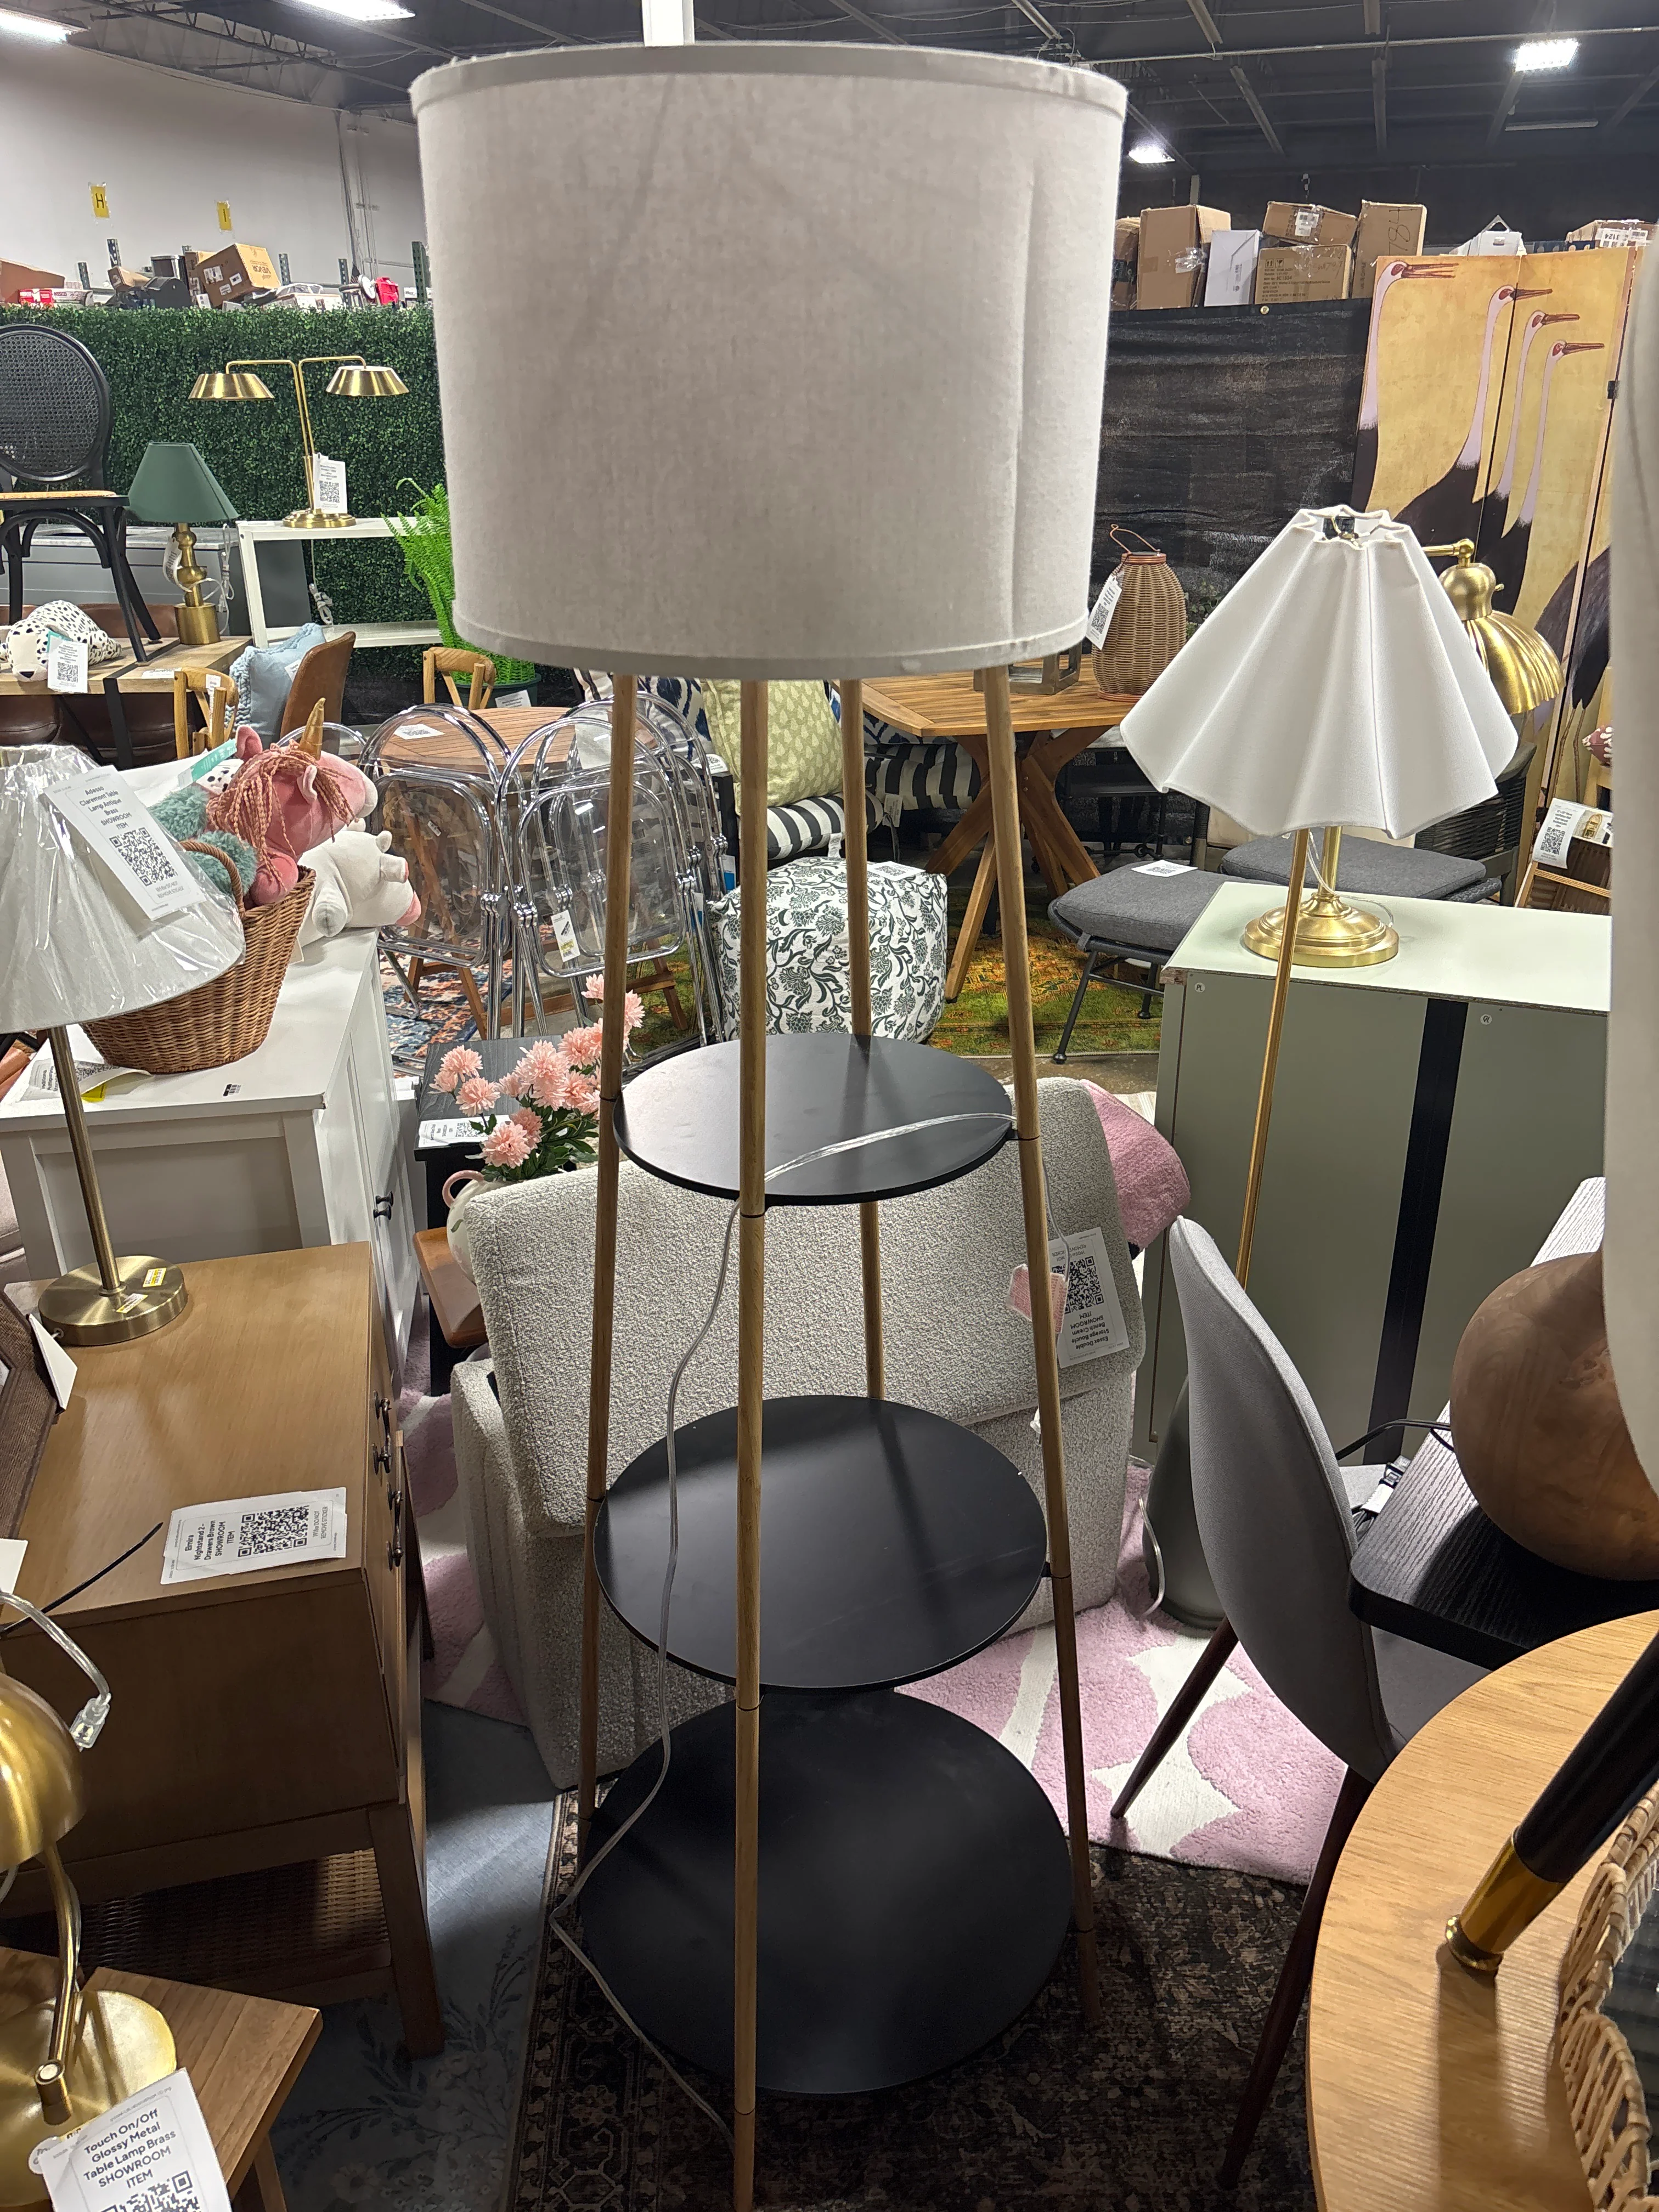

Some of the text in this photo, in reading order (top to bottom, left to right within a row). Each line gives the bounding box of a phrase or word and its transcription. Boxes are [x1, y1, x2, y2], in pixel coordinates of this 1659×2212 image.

[95, 193, 104, 208] H
[84, 786, 104, 795] Adesso
[79, 793, 107, 806] Claremont
[88, 798, 122, 812] Lamp Antique
[100, 812, 132, 826] SHOWROOM
[1070, 1315, 1104, 1329] SHOWROOM
[1079, 1311, 1092, 1319] ITEM
[1090, 1322, 1105, 1330] Bench
[1071, 1329, 1109, 1343] Storage Boucle
[1075, 1341, 1093, 1350] Double
[184, 1534, 194, 1551] Elmira
[204, 1520, 216, 1560] Drawers Brown
[215, 1521, 226, 1556] SHOWROOM
[227, 1531, 235, 1544] ITEM
[194, 1531, 205, 1560] Nightstand
[84, 2132, 118, 2154] Touch
[118, 2108, 158, 2135] On/Off
[92, 2138, 128, 2162] Glossy
[129, 2121, 161, 2143] Metal
[83, 2131, 176, 2181] Table Lamp Brass
[98, 2146, 171, 2187] SHOWROOM
[126, 2169, 153, 2188] ITEM
